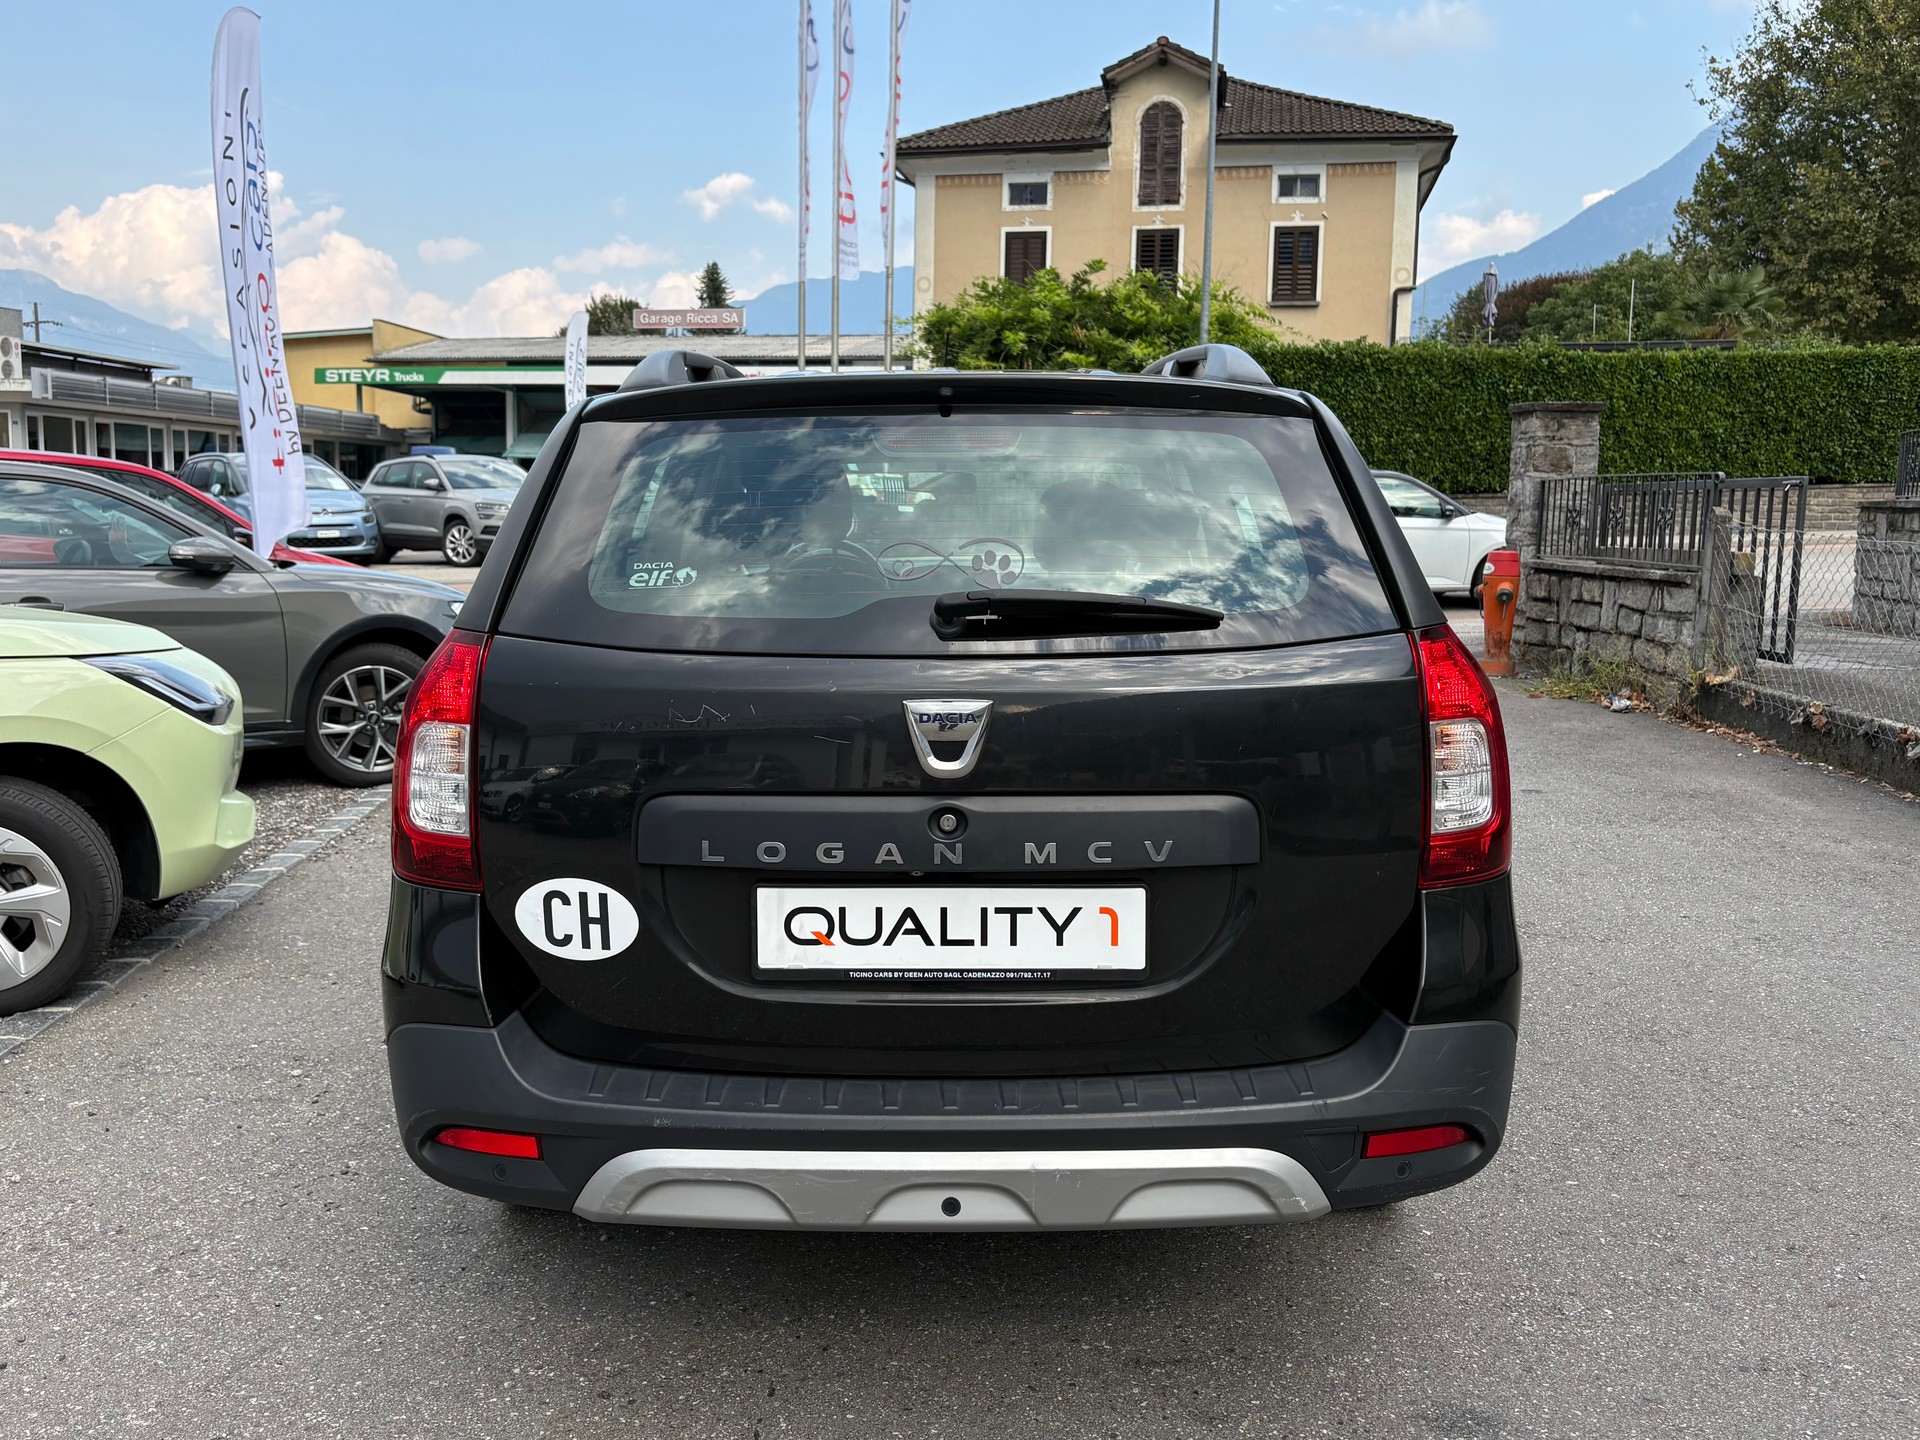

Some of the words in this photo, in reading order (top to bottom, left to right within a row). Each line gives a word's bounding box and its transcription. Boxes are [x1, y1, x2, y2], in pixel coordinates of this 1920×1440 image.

[640, 313, 682, 325] Garage
[686, 313, 718, 323] Ricca
[722, 313, 739, 323] SA
[325, 369, 390, 382] STEYR
[394, 372, 425, 382] Trucks
[633, 562, 674, 570] DACIA
[629, 570, 674, 587] elf
[919, 713, 977, 724] DACIA
[701, 840, 963, 865] LOGAN
[1024, 840, 1174, 864] MCV
[543, 889, 611, 951] CH
[783, 906, 1083, 947] QUALITY
[1098, 906, 1119, 947] 1
